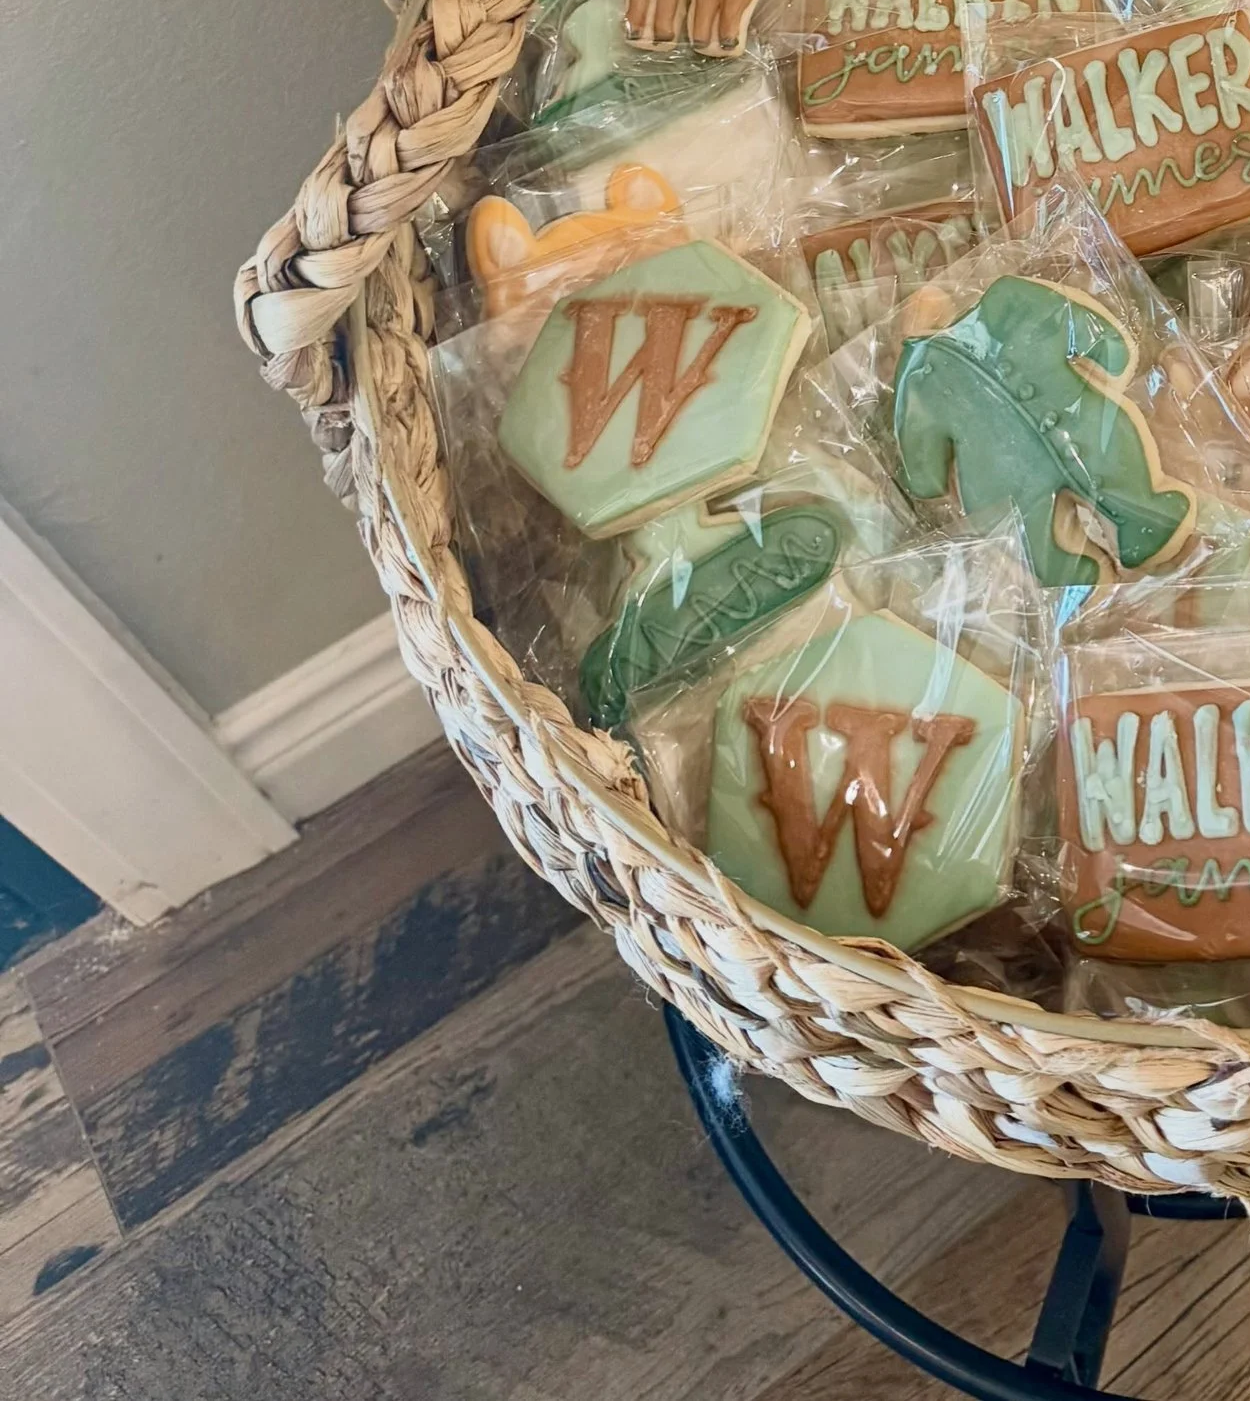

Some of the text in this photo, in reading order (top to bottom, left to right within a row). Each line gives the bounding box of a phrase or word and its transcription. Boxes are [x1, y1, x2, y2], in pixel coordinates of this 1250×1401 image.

[803, 41, 964, 107] jam
[560, 294, 758, 470] W
[745, 696, 977, 919] W
